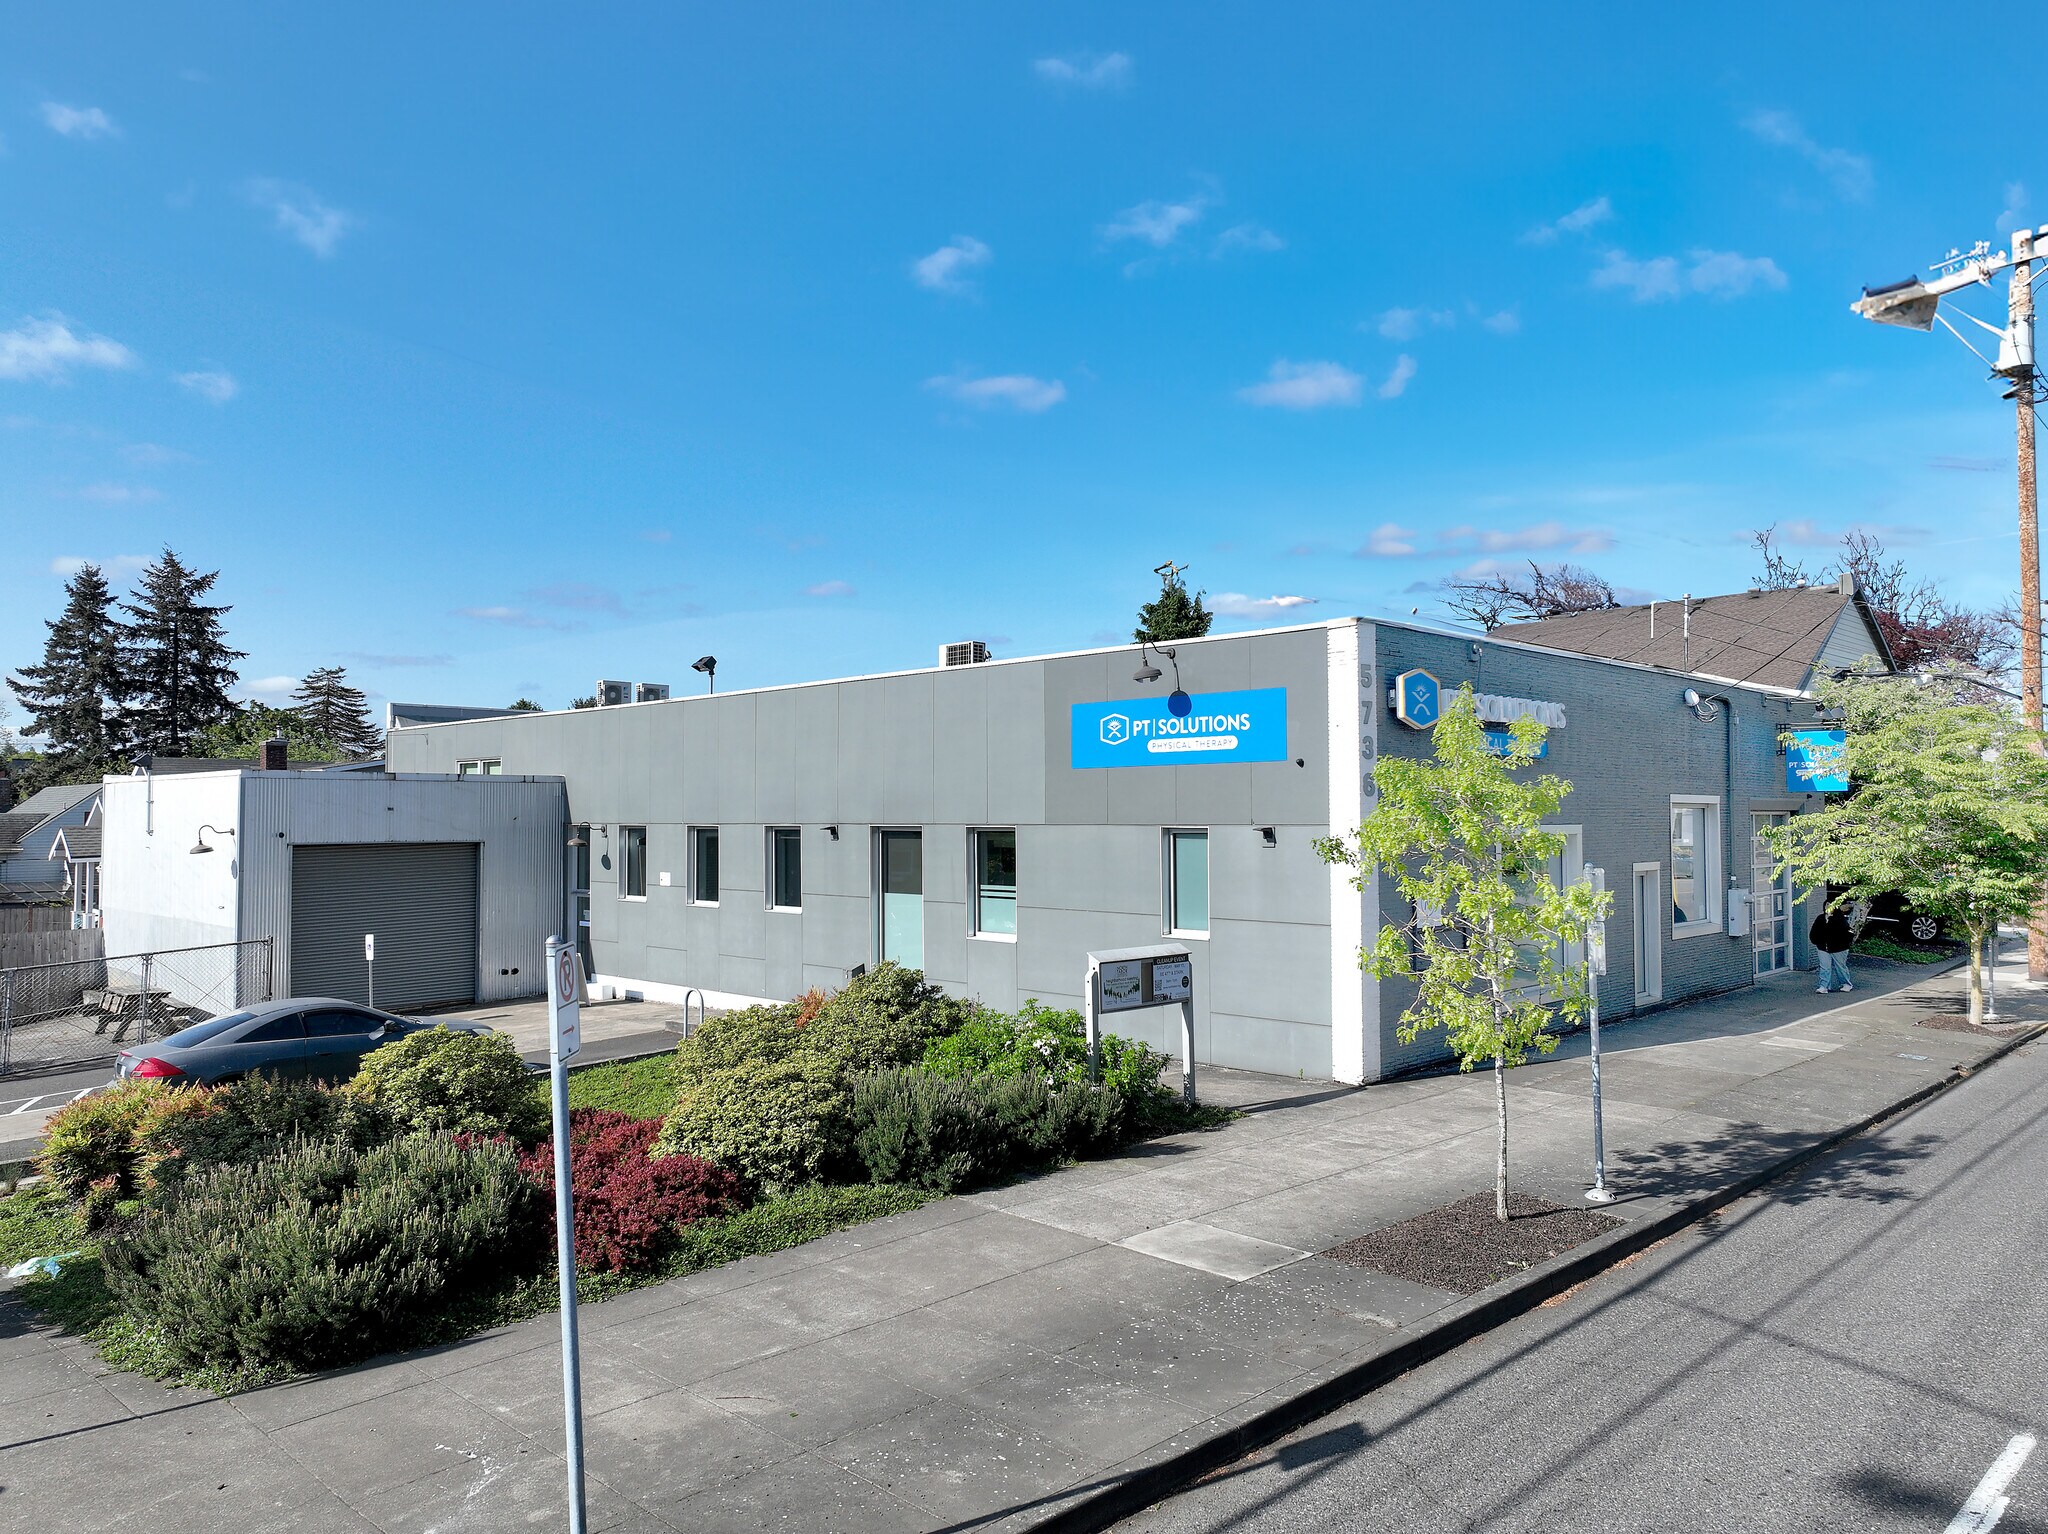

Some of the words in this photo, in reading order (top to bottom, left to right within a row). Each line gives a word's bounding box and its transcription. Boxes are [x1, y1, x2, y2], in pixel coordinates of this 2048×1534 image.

[1472, 692, 1567, 729] SOLUTIONS
[1133, 719, 1151, 737] PT
[1158, 713, 1251, 735] SOLUTIONS
[1152, 742, 1191, 750] PHYSICAL
[1195, 739, 1233, 748] THERAPY
